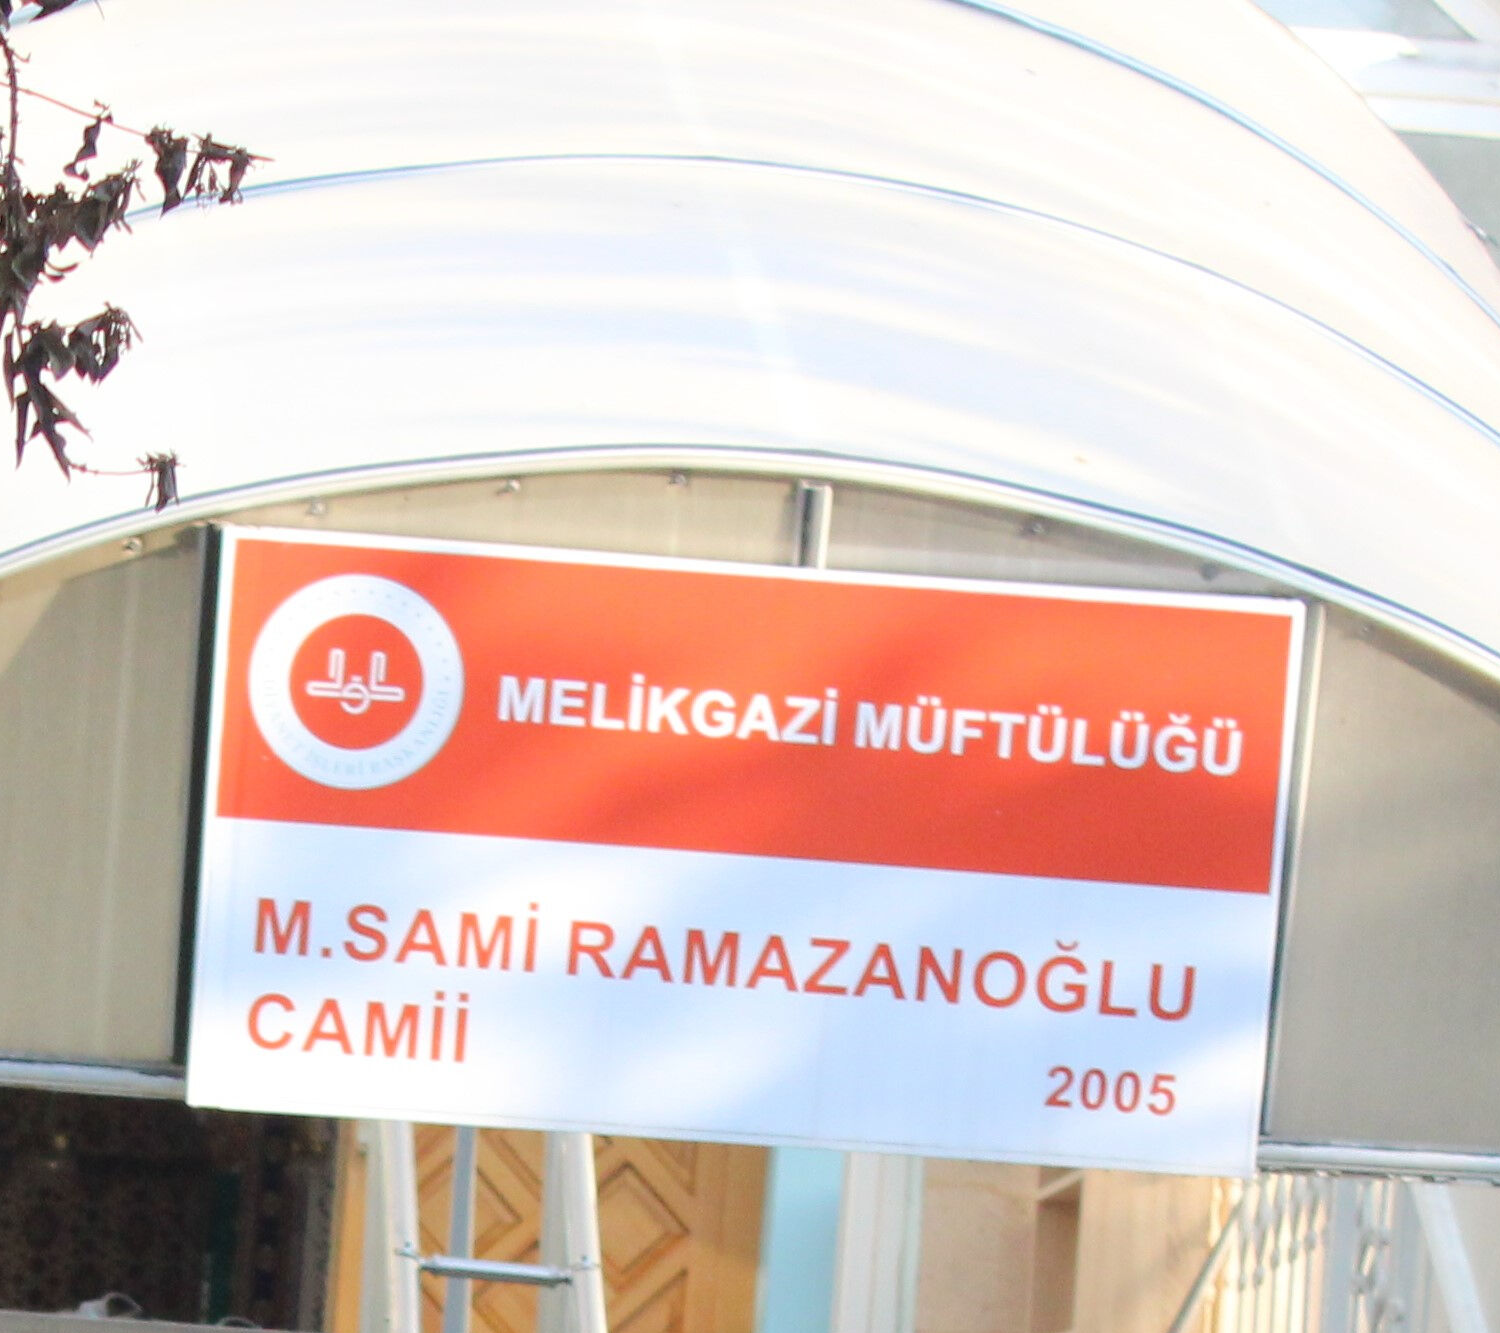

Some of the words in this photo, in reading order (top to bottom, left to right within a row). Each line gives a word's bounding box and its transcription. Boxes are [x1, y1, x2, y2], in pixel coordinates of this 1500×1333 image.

[498, 673, 839, 746] MELİKGAZİ
[855, 695, 1244, 777] MÜFTÜLÜĞÜ
[255, 898, 538, 972] M.SAMİ
[568, 920, 1195, 1020] RAMAZANOĞLU
[247, 991, 468, 1063] CAMİİ
[1045, 1068, 1176, 1115] 2005
